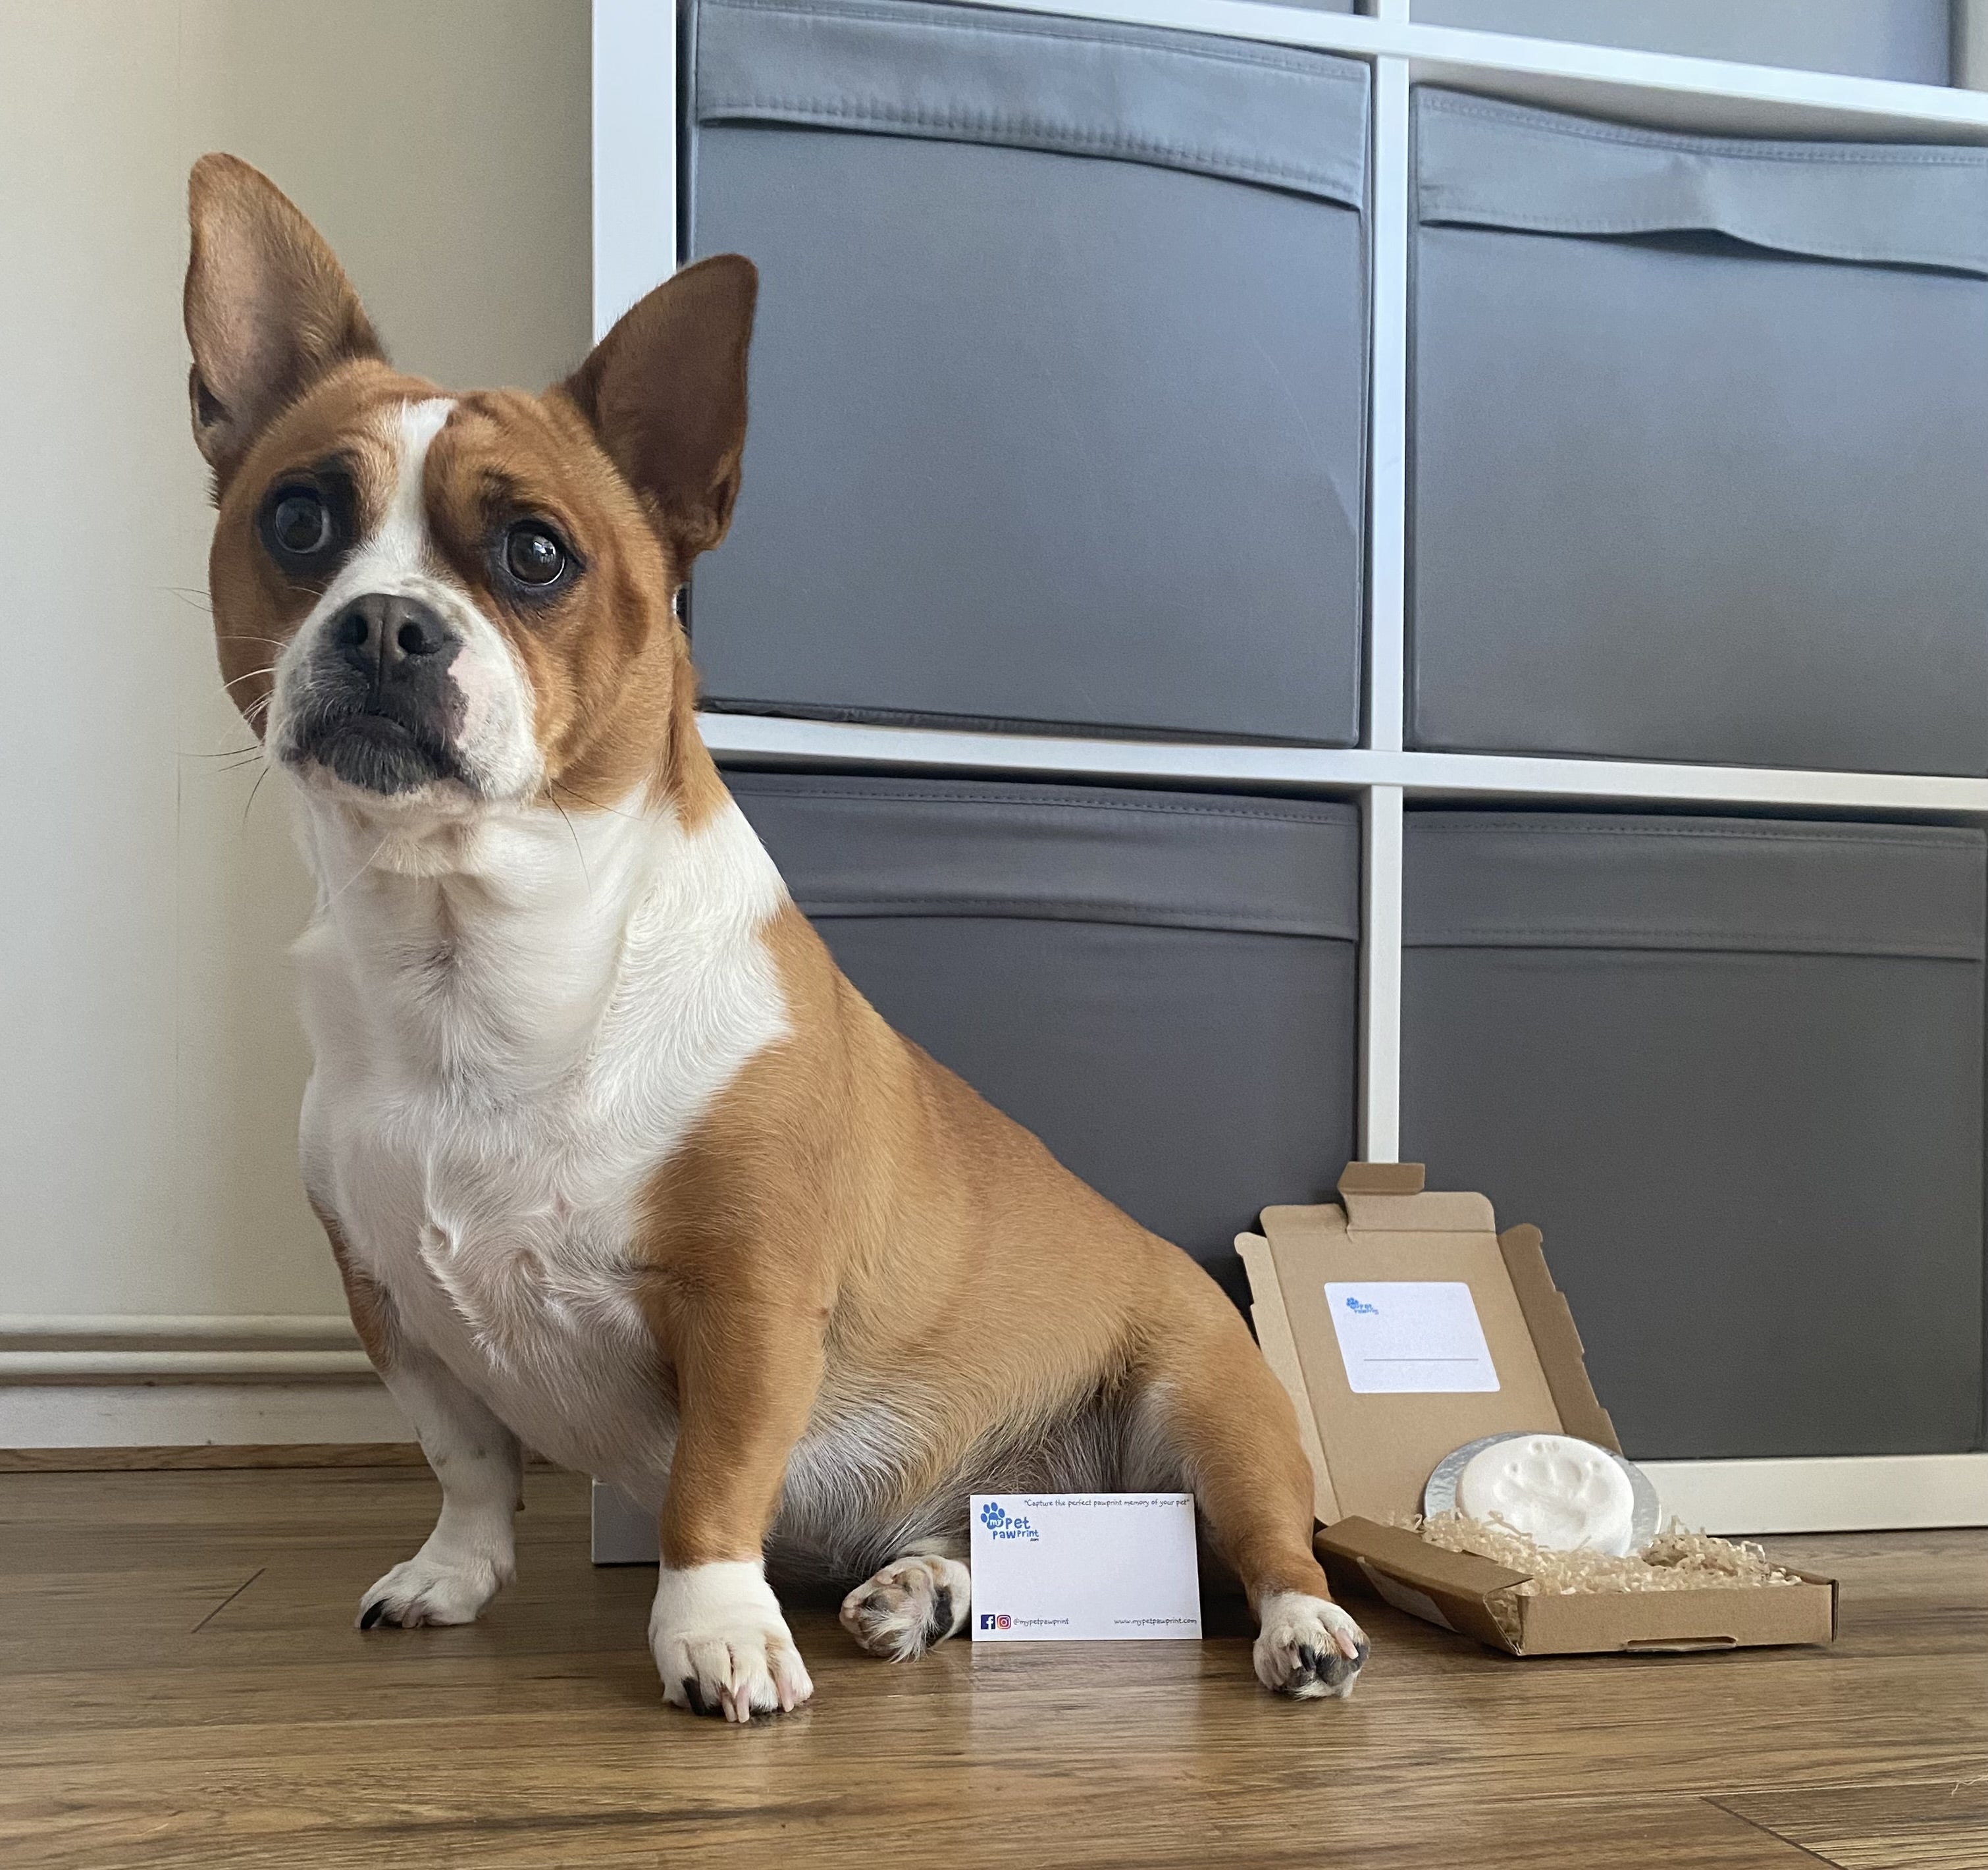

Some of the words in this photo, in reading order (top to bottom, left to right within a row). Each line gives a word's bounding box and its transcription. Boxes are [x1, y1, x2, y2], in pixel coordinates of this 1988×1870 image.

[1024, 1499, 1053, 1507] "Capture
[1093, 1499, 1122, 1507] pawprint
[1013, 1618, 1069, 1627] @mypetpawprint
[1114, 1617, 1197, 1626] www.mypetpawprint.com
